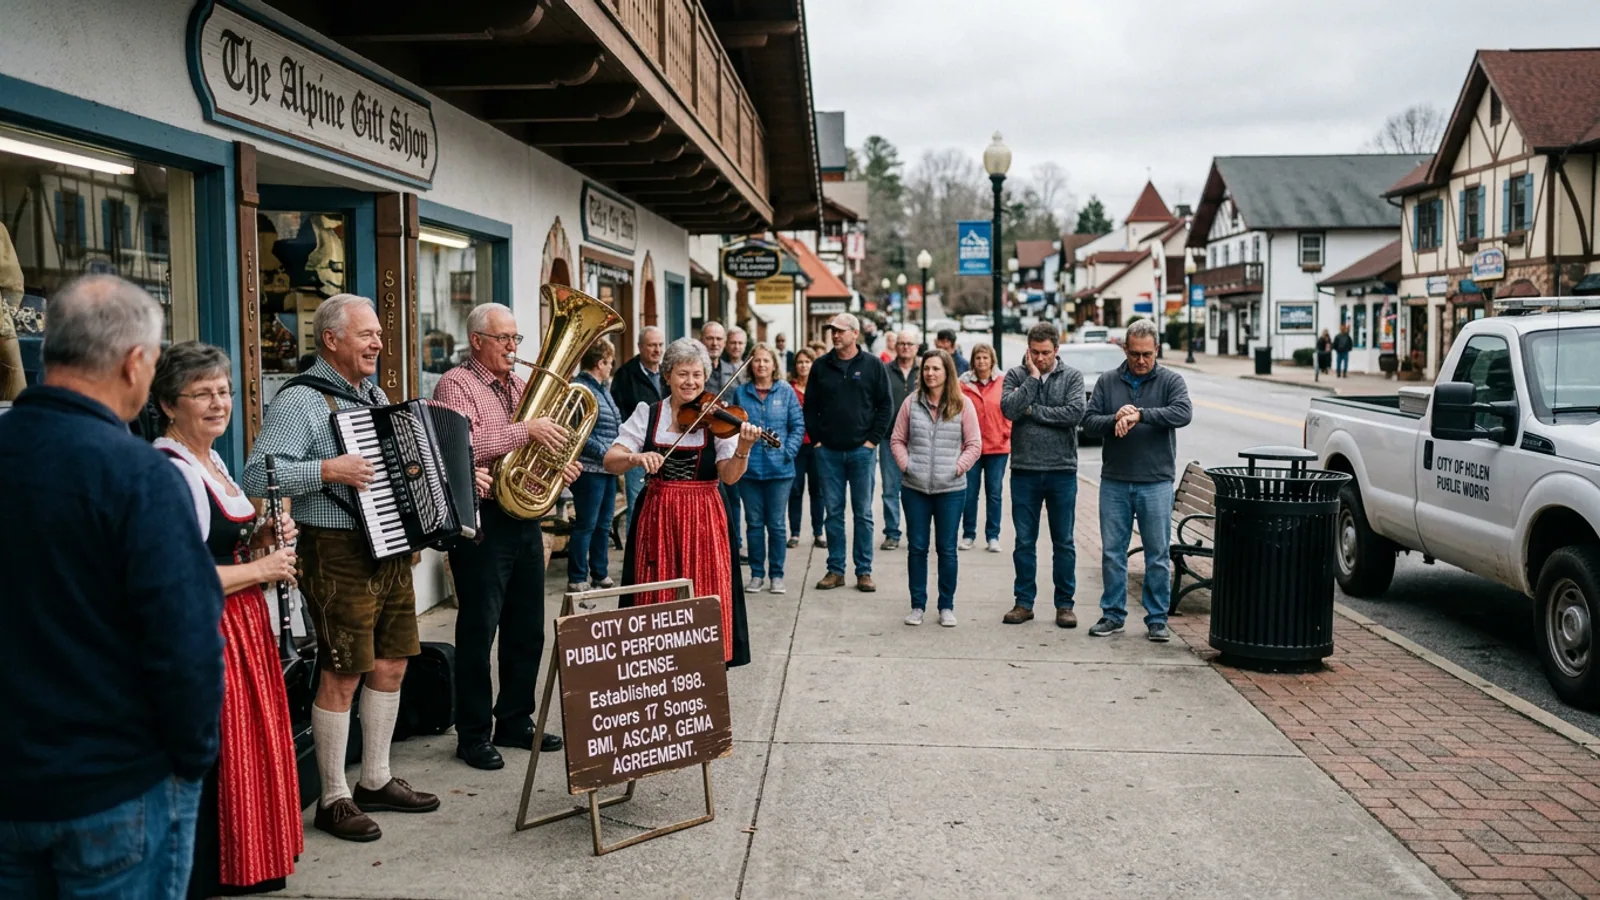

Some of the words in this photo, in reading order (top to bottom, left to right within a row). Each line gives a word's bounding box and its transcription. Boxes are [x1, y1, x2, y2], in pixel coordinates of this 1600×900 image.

[220, 28, 271, 105] The
[280, 56, 345, 129] Alpine
[351, 89, 384, 145] Gift
[389, 106, 428, 168] Shop
[1455, 459, 1464, 474] OF
[591, 618, 622, 640] CITY
[629, 614, 647, 633] OF
[652, 608, 694, 629] HELEN
[566, 643, 617, 667] PUBLIC
[622, 625, 719, 657] PERFORMANCE
[618, 654, 679, 681] LICENSE.
[590, 679, 667, 709] Established
[672, 672, 706, 692] 1998.
[592, 711, 640, 732] Covers
[645, 703, 659, 720] 17
[664, 698, 707, 717] Songs.
[588, 736, 618, 757] BMI,
[623, 725, 672, 749] ASCAP,
[676, 714, 714, 738] GEMA
[612, 740, 698, 775] AGREEMENT.
